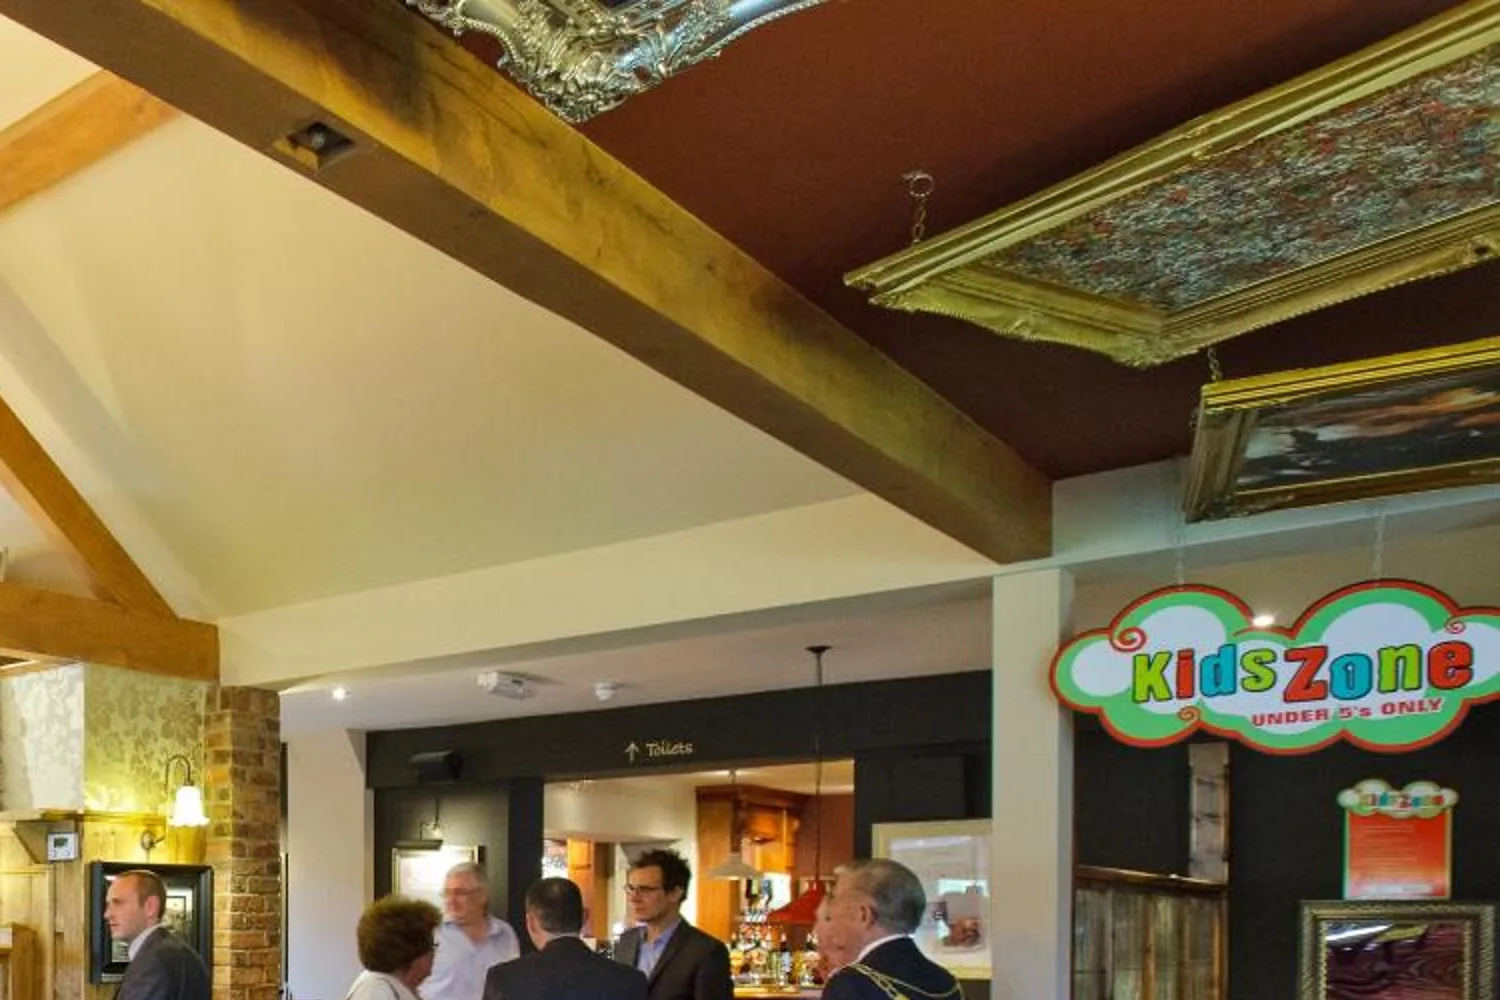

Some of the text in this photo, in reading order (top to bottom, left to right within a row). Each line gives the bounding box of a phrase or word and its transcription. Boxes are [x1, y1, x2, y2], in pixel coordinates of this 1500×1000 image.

[1252, 698, 1442, 726] UNDER 5's ONLY
[646, 740, 693, 757] Toilets
